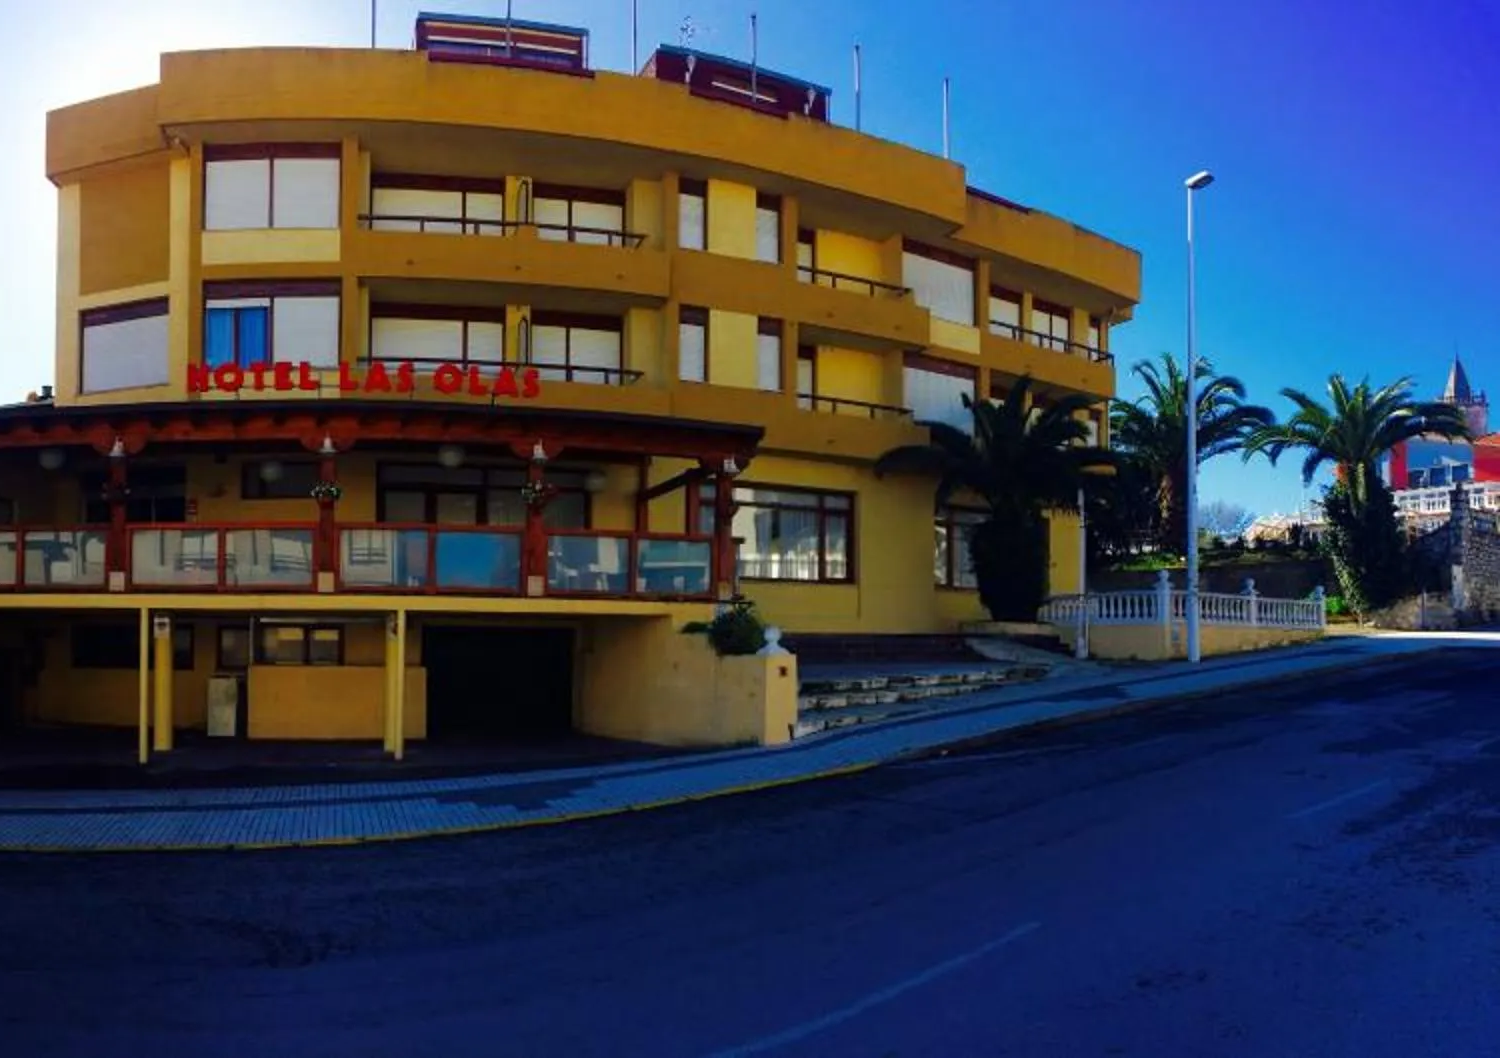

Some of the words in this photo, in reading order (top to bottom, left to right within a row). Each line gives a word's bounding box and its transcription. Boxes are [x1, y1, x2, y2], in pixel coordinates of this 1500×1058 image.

[187, 361, 318, 392] HOTEL
[339, 360, 414, 393] LAS
[433, 364, 540, 397] OLAS
